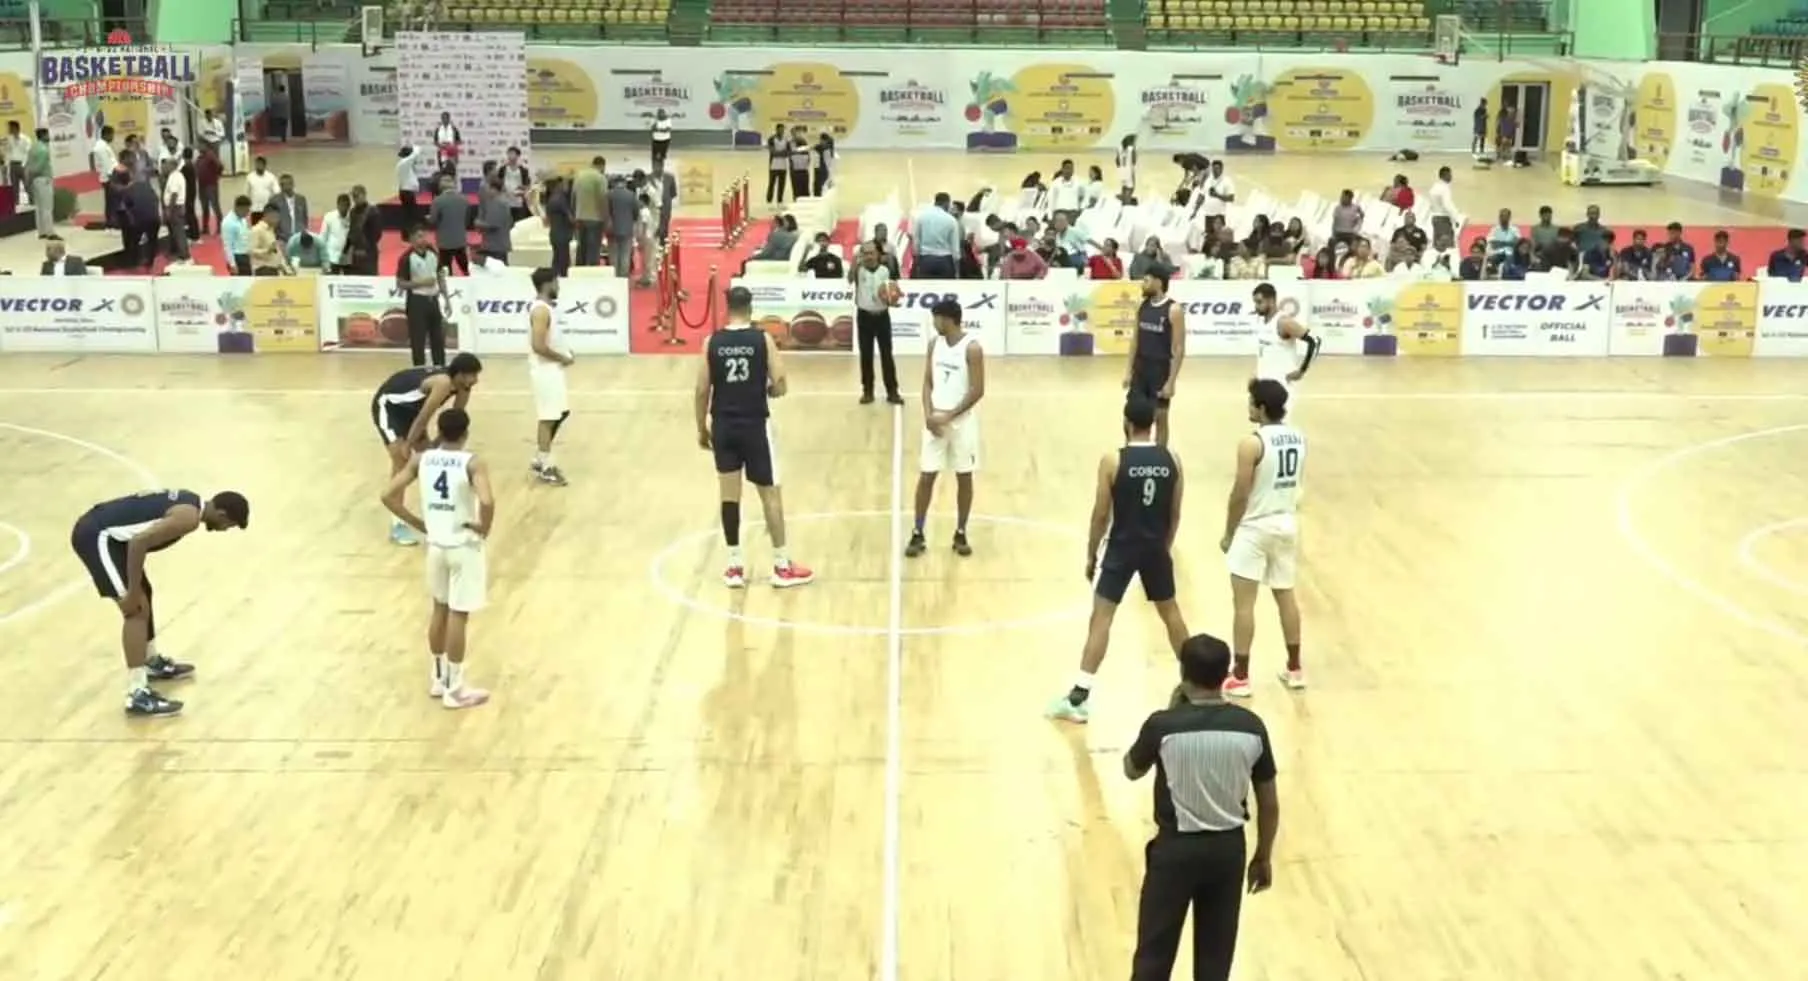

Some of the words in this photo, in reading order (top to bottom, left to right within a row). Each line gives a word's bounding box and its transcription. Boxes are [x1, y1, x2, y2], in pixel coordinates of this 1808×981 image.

[624, 87, 689, 99] BASKETBALL
[880, 90, 944, 103] BASKETBALL
[1142, 91, 1206, 104] BASKETBALL
[1397, 95, 1461, 108] BASKETBALL
[802, 291, 853, 300] VECTOR
[0, 298, 82, 312] VECTOR
[1181, 302, 1242, 315] ECTOR
[1467, 294, 1566, 311] VECTOR
[1540, 321, 1586, 331] OFFICIAL
[718, 346, 754, 356] COSCO
[725, 358, 750, 383] 23
[1277, 448, 1298, 478] 10
[1128, 465, 1170, 478] COSCO
[433, 469, 449, 500] 4
[1142, 478, 1157, 506] 9
